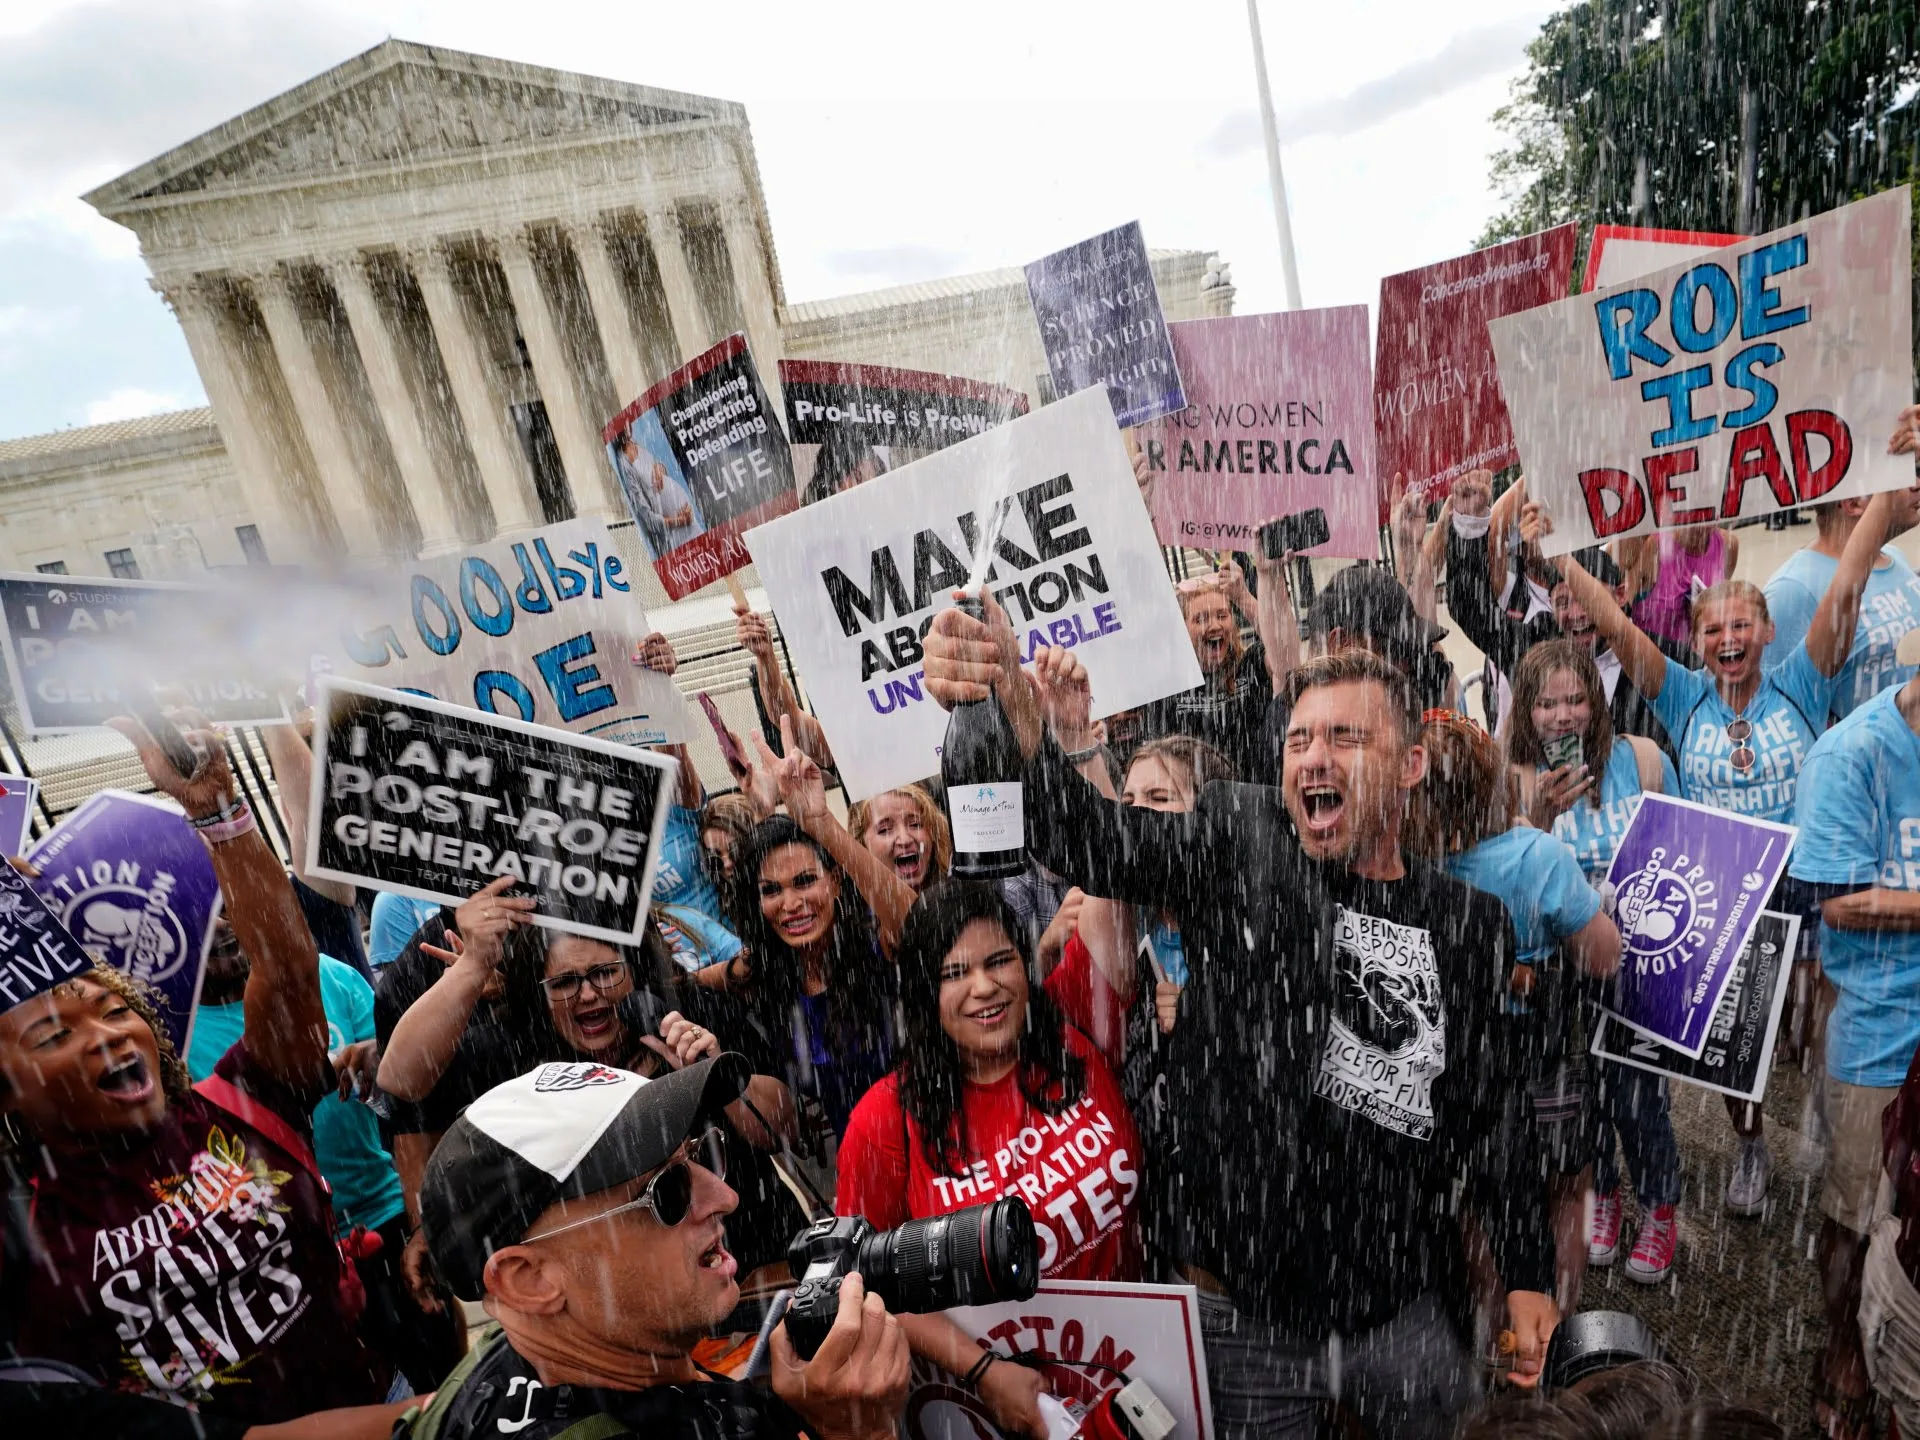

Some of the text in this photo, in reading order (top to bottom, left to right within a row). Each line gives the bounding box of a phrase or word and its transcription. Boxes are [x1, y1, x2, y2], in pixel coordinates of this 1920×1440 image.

[1422, 252, 1549, 303] ConcernedWomen.org
[1045, 282, 1149, 337] SCIENCE
[1594, 233, 1811, 381] ROE
[1054, 318, 1156, 369] PROVED
[670, 374, 748, 427] Championing
[677, 392, 757, 447] Protecting
[794, 400, 897, 426] Pro-Life
[903, 407, 921, 427] is
[1208, 400, 1324, 428] WOMEN
[1377, 362, 1468, 423] WOMEN
[1641, 343, 1786, 448] IS
[686, 414, 767, 468] Defending
[1178, 438, 1354, 475] AMERICA
[705, 448, 772, 500] LIFE
[1578, 410, 1853, 538] DEAD
[669, 547, 720, 587] WOMEN
[821, 473, 1093, 638] MAKE
[26, 606, 136, 633] I AM
[861, 555, 1109, 683] ABTION
[392, 631, 618, 723] OE
[1755, 708, 1799, 749] HE
[350, 726, 367, 757] I
[396, 740, 495, 787] AM
[522, 766, 636, 821] THE
[330, 762, 649, 867] POST-ROE
[334, 815, 631, 906] GENERATION
[451, 876, 480, 891] LIFE
[1619, 847, 1667, 967] CONCEPTION
[1636, 853, 1718, 977] PROTECTION
[1663, 885, 1688, 918] AT
[1343, 925, 1439, 973] DISPOSABL
[1360, 917, 1414, 945] BEINGS
[1692, 890, 1750, 1006] STUDENTSFORLIFE.ORG
[1737, 953, 1773, 1063] STUDENTSFORLIFE.ORG
[1365, 1053, 1399, 1087] FOR
[1704, 1045, 1728, 1068] IS
[1315, 1071, 1367, 1111] IVORS
[933, 1159, 996, 1207] THE
[996, 1111, 1116, 1208] ERATION
[93, 1145, 242, 1283] ADOPTION
[1034, 1148, 1139, 1270] OTES
[100, 1182, 287, 1342] SAVES
[130, 1239, 302, 1392] LIVES
